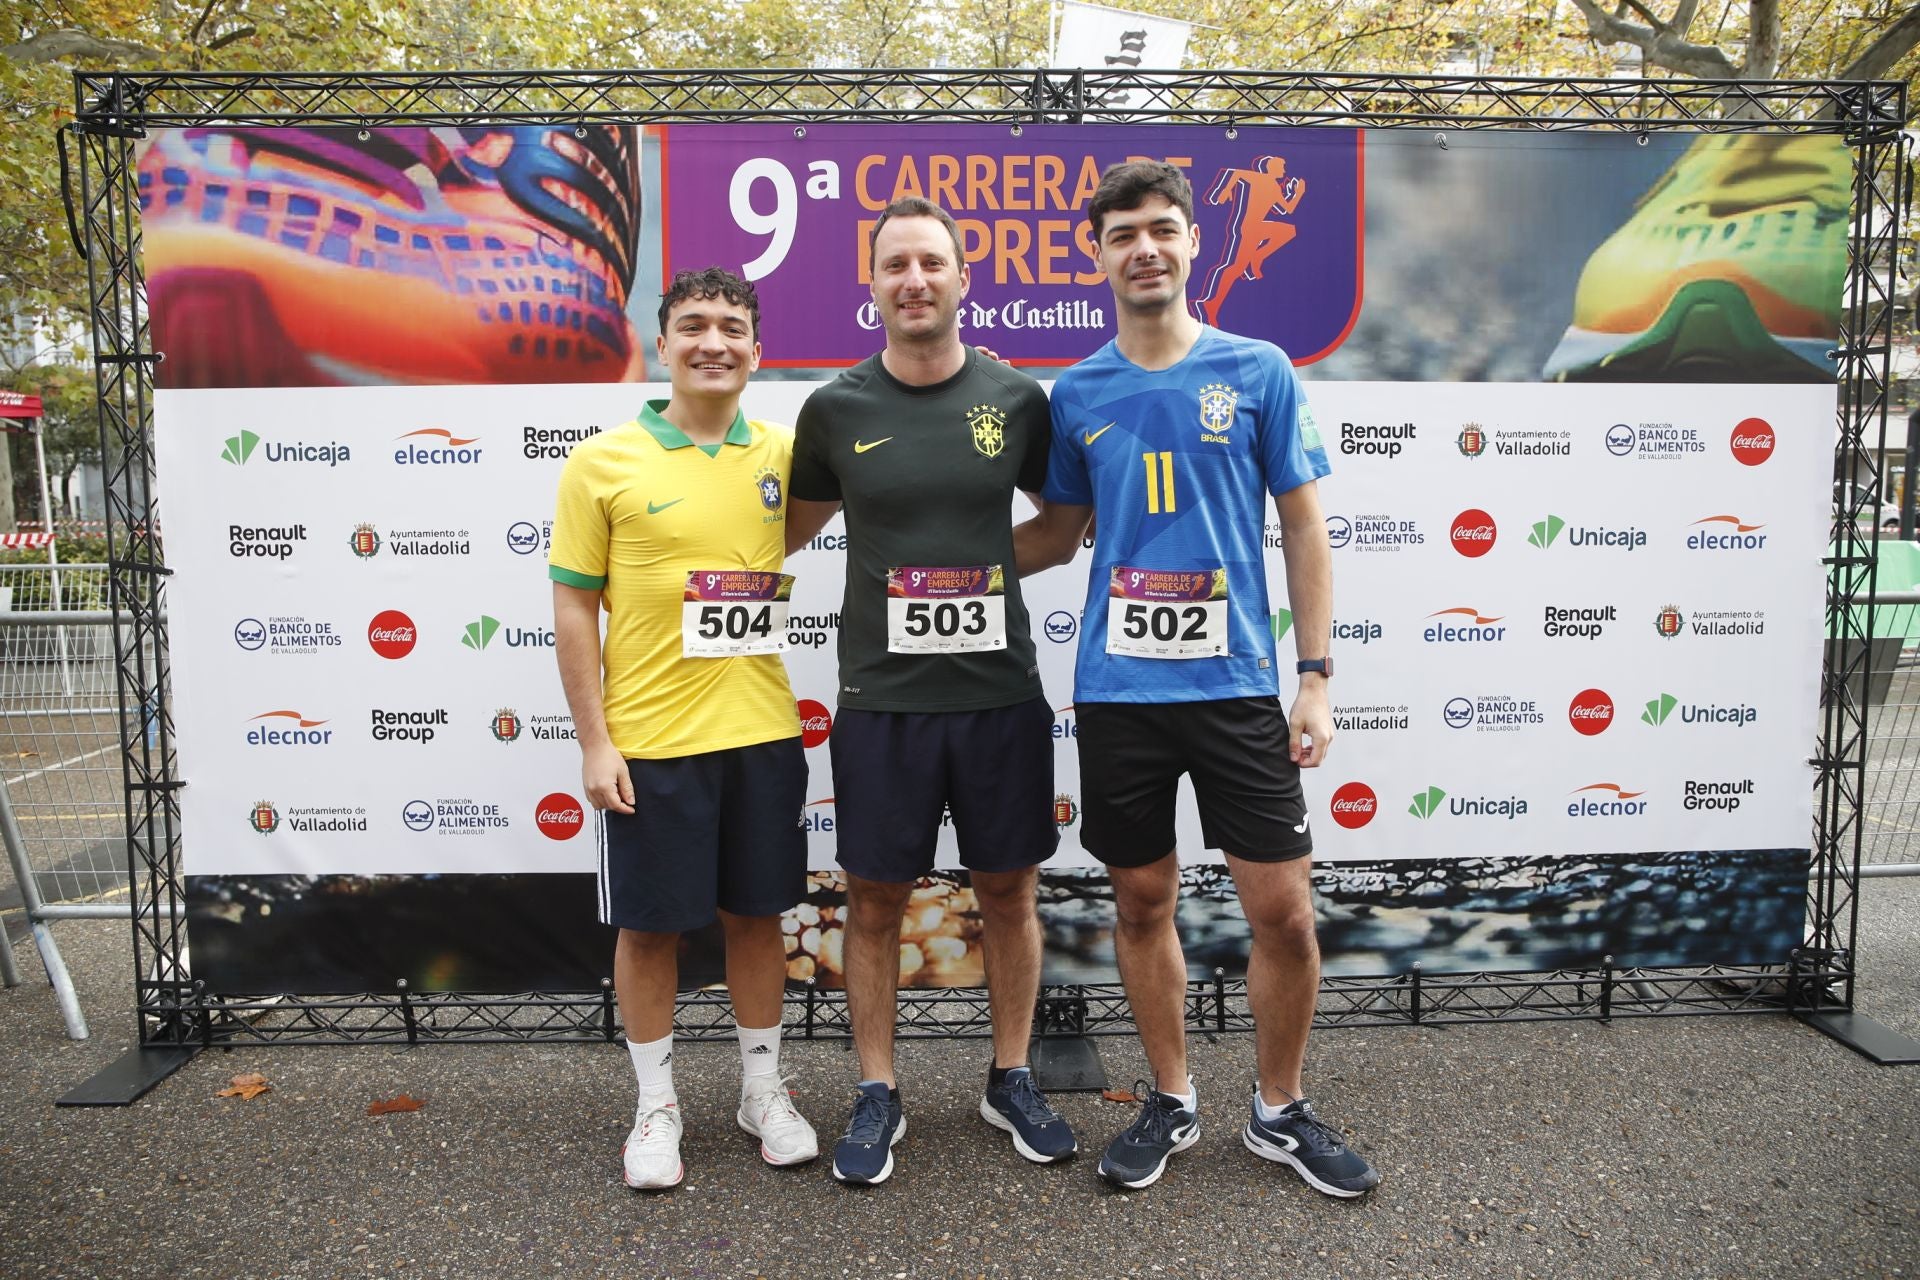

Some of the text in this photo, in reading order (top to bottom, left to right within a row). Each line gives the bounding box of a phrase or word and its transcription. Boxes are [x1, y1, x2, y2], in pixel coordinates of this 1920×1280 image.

[855, 154, 1100, 211] CARRERA
[971, 301, 997, 329] de
[1001, 298, 1106, 330] Castilla
[1342, 423, 1416, 439] Renault
[1496, 430, 1570, 440] Ayuntamiento de
[1639, 430, 1697, 440] BANCO DE
[1200, 434, 1231, 444] BRASIL
[266, 441, 350, 467] Unicaja
[395, 444, 482, 464] elecnor
[524, 443, 573, 459] Grou
[1341, 439, 1401, 459] Group
[1496, 442, 1570, 455] Valladolid
[1639, 442, 1705, 452] ALIMENTOS
[1142, 451, 1176, 514] 11
[230, 525, 306, 541] Renault
[390, 529, 469, 540] Ayuntamiento de
[1355, 522, 1415, 532] BANCO DE
[1356, 534, 1424, 544] ALIMENTOS
[1570, 527, 1646, 551] Unicaja
[1687, 530, 1766, 549] elecnor
[230, 541, 292, 560] Group
[390, 541, 469, 555] Valladolid
[721, 574, 750, 582] CARRERA
[927, 571, 960, 579] CARRERA
[1145, 573, 1179, 582] CARRERA
[1182, 574, 1190, 582] DE
[721, 582, 760, 591] EMPRESAS
[927, 579, 970, 588] EMPRESAS
[1145, 581, 1190, 591] EMPRESAS
[785, 613, 840, 628] nault
[904, 601, 987, 636] 503
[1545, 606, 1616, 621] Renault
[1693, 610, 1764, 620] Ayuntamiento de
[270, 623, 331, 634] BANCO DE
[698, 605, 772, 639] 504
[1123, 604, 1207, 641] 502
[1692, 621, 1763, 635] Valladolid
[506, 627, 555, 647] Unic
[1329, 619, 1382, 644] icaja
[1424, 623, 1505, 642] elecnor
[1544, 622, 1602, 640] Group
[271, 636, 341, 646] ALIMENTOS
[787, 632, 827, 649] oup
[1333, 706, 1395, 715] Ayuntamiento
[1477, 702, 1535, 712] BANCO DE
[372, 709, 448, 725] Renault
[1333, 716, 1408, 730] Valladolid
[1477, 713, 1543, 724] ALIMENTOS
[1682, 704, 1756, 727] Unicaja
[247, 726, 332, 745] elecnor
[372, 725, 434, 744] Group
[1685, 780, 1754, 795] Renault
[289, 807, 352, 816] Ayuntamiento
[438, 805, 499, 815] BANCO DE
[1451, 796, 1527, 819] Unicaja
[1568, 798, 1647, 816] elecnor
[1684, 795, 1740, 813] Group
[289, 818, 366, 831] Valladolid
[439, 817, 508, 827] ALIMENTOS
